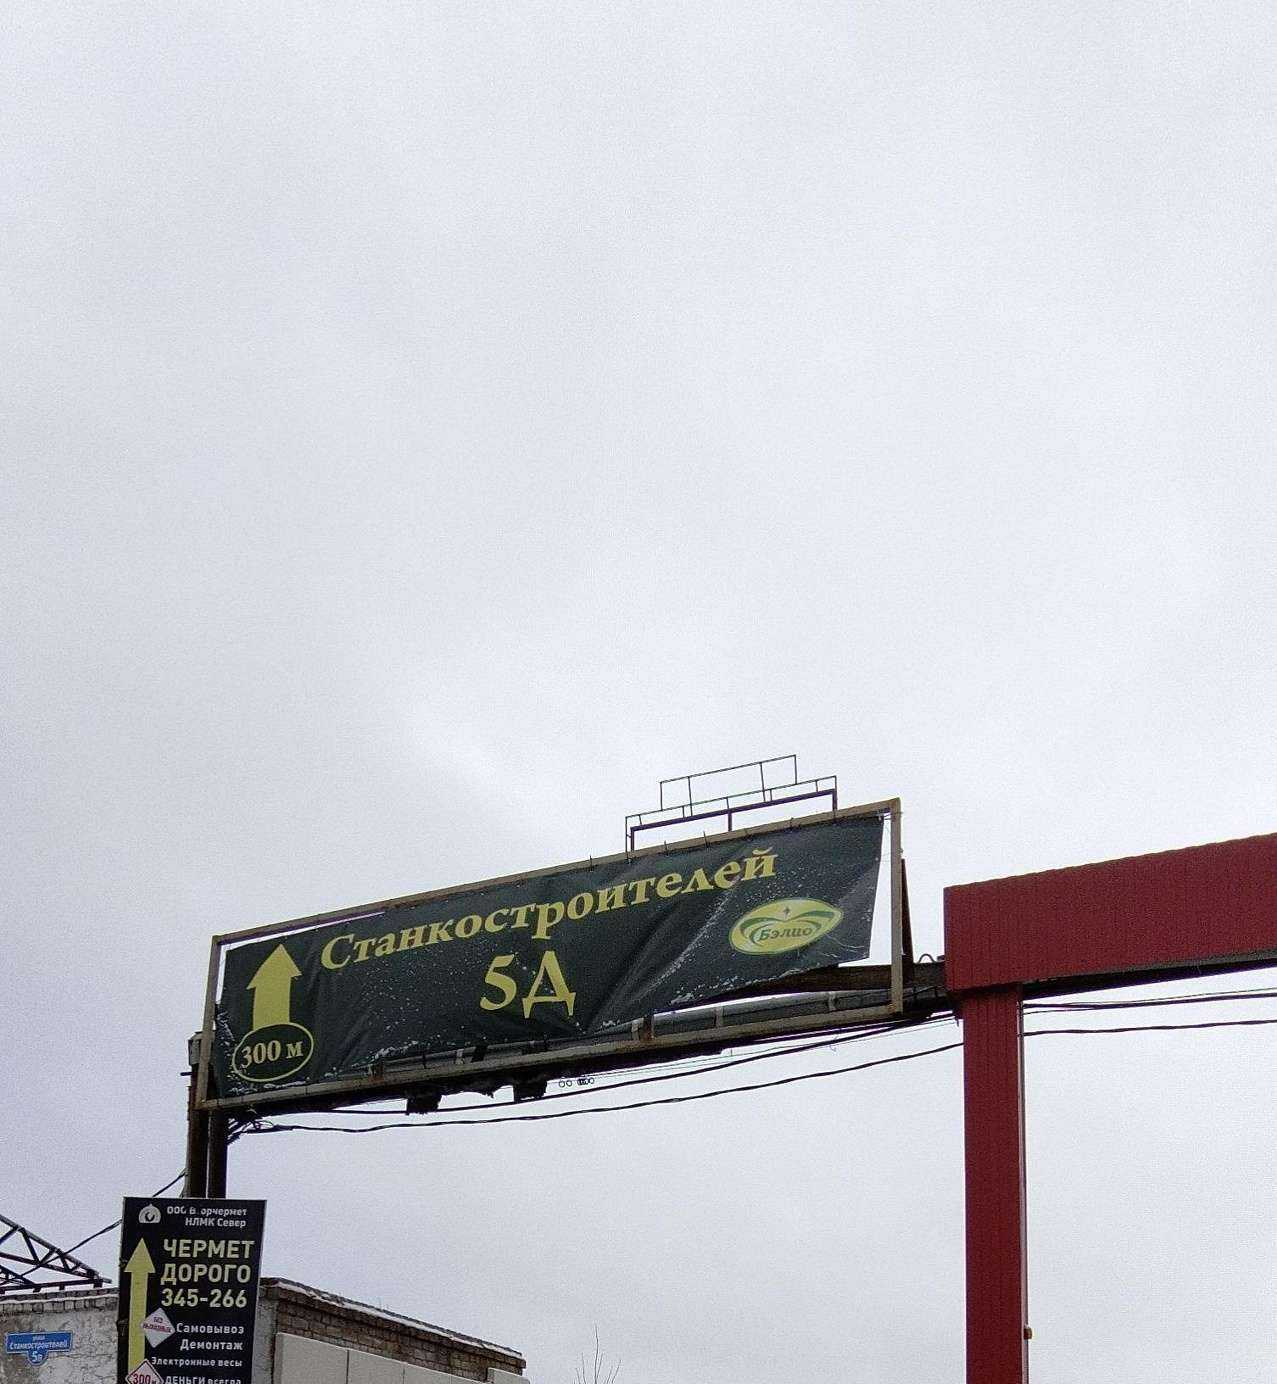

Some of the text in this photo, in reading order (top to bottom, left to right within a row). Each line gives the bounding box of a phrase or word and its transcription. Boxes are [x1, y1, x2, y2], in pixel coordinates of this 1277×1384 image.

[320, 847, 778, 970] Станкостроителей
[480, 949, 576, 1019] 5Д
[241, 1040, 304, 1069] 300 м
[185, 1217, 246, 1228] НЛМК Север
[163, 1239, 254, 1258] ЧЕРМЕТ
[160, 1263, 251, 1285] ДОРОГО
[161, 1288, 247, 1307] 345-266
[176, 1323, 244, 1334] Самовывоз
[180, 1339, 243, 1350] Демонтаж
[151, 1357, 216, 1367] Электронные
